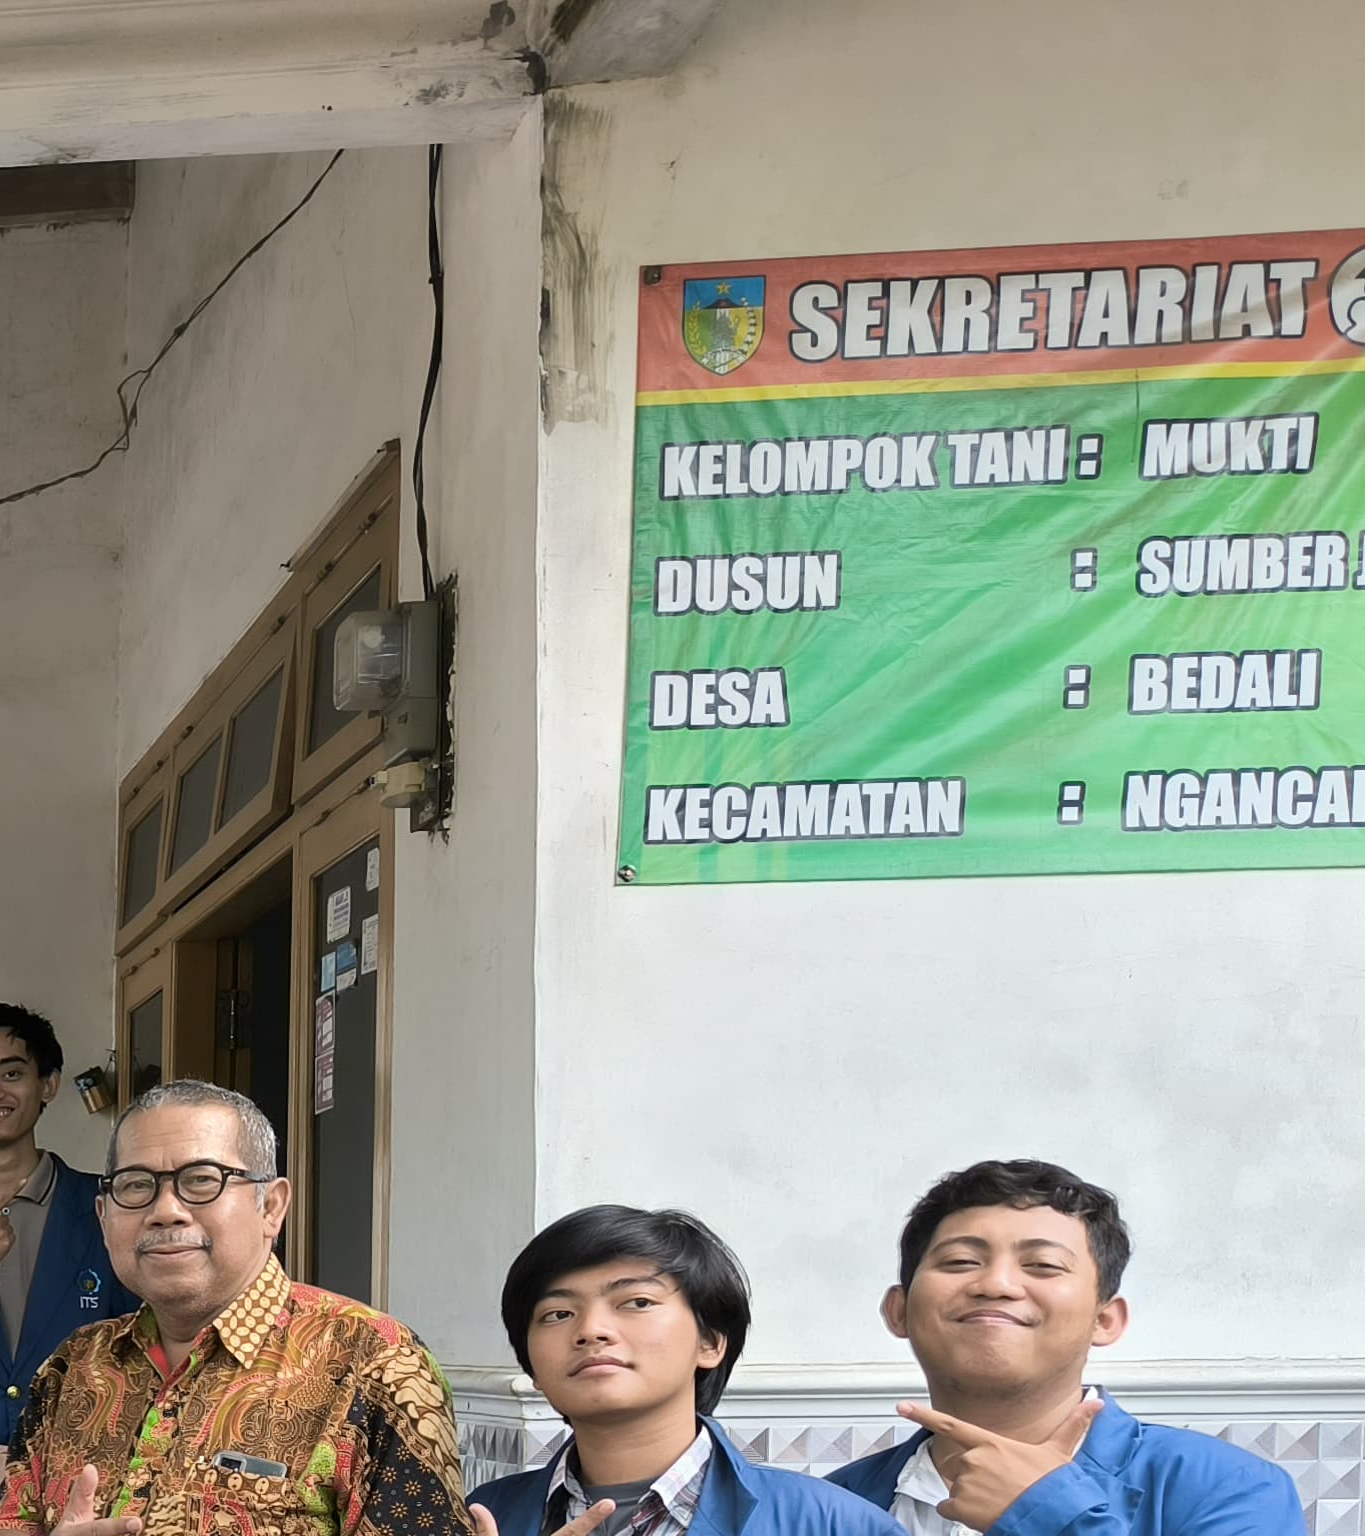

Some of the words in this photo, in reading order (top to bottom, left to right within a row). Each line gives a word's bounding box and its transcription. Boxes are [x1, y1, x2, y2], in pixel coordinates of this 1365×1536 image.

[790, 259, 1319, 361] SEKRETARIAT
[660, 433, 939, 499] KELOMPOK
[944, 426, 1068, 489] TANI
[1140, 413, 1319, 481] MUKTI
[654, 550, 842, 616] DUSUN
[1136, 530, 1349, 597] SUMBER
[649, 667, 790, 731] DESA
[1128, 648, 1322, 714] BEDALI
[644, 778, 965, 844] KECAMATAN
[80, 1296, 99, 1308] ITS
